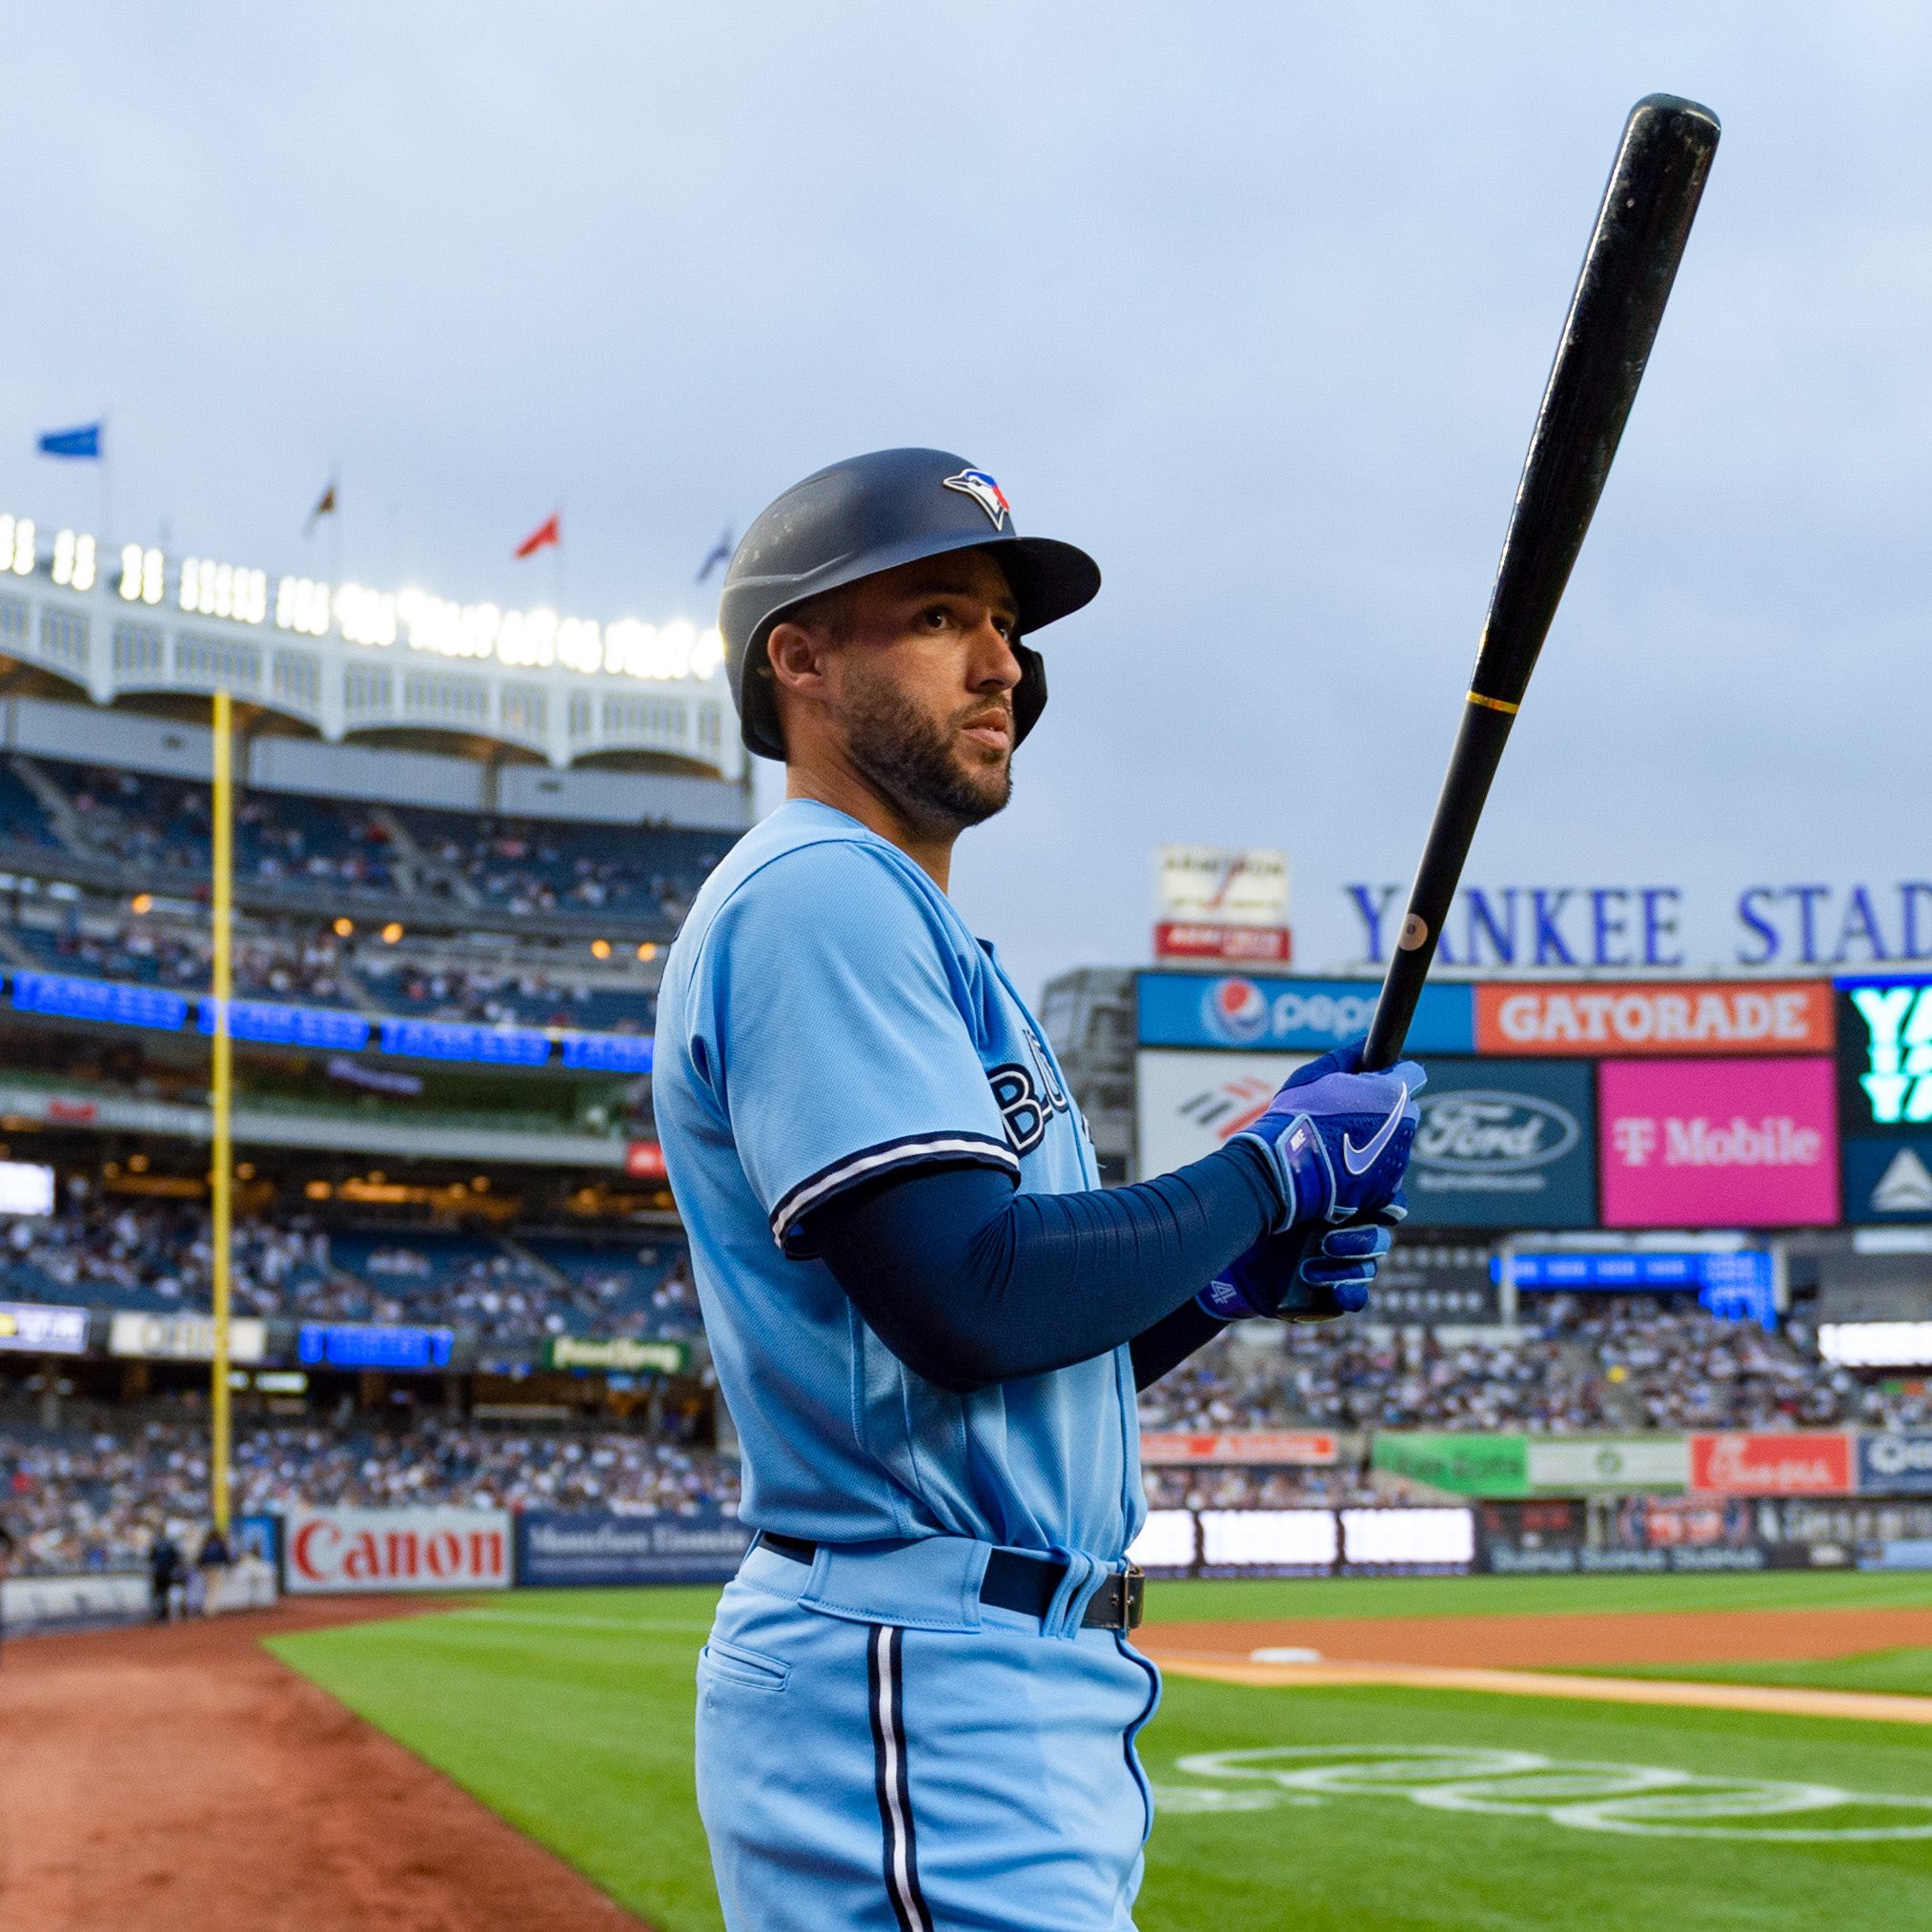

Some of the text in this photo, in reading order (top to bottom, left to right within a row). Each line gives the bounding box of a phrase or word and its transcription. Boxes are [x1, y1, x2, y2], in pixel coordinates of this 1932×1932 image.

[1345, 884, 1682, 966] YNKEE
[1272, 993, 1381, 1039] pep
[1497, 992, 1808, 1042] GATORADE
[1417, 1102, 1546, 1158] Ford
[1665, 1117, 1822, 1166] Mobile
[1210, 1280, 1237, 1305] 4
[293, 1518, 503, 1582] Canon
